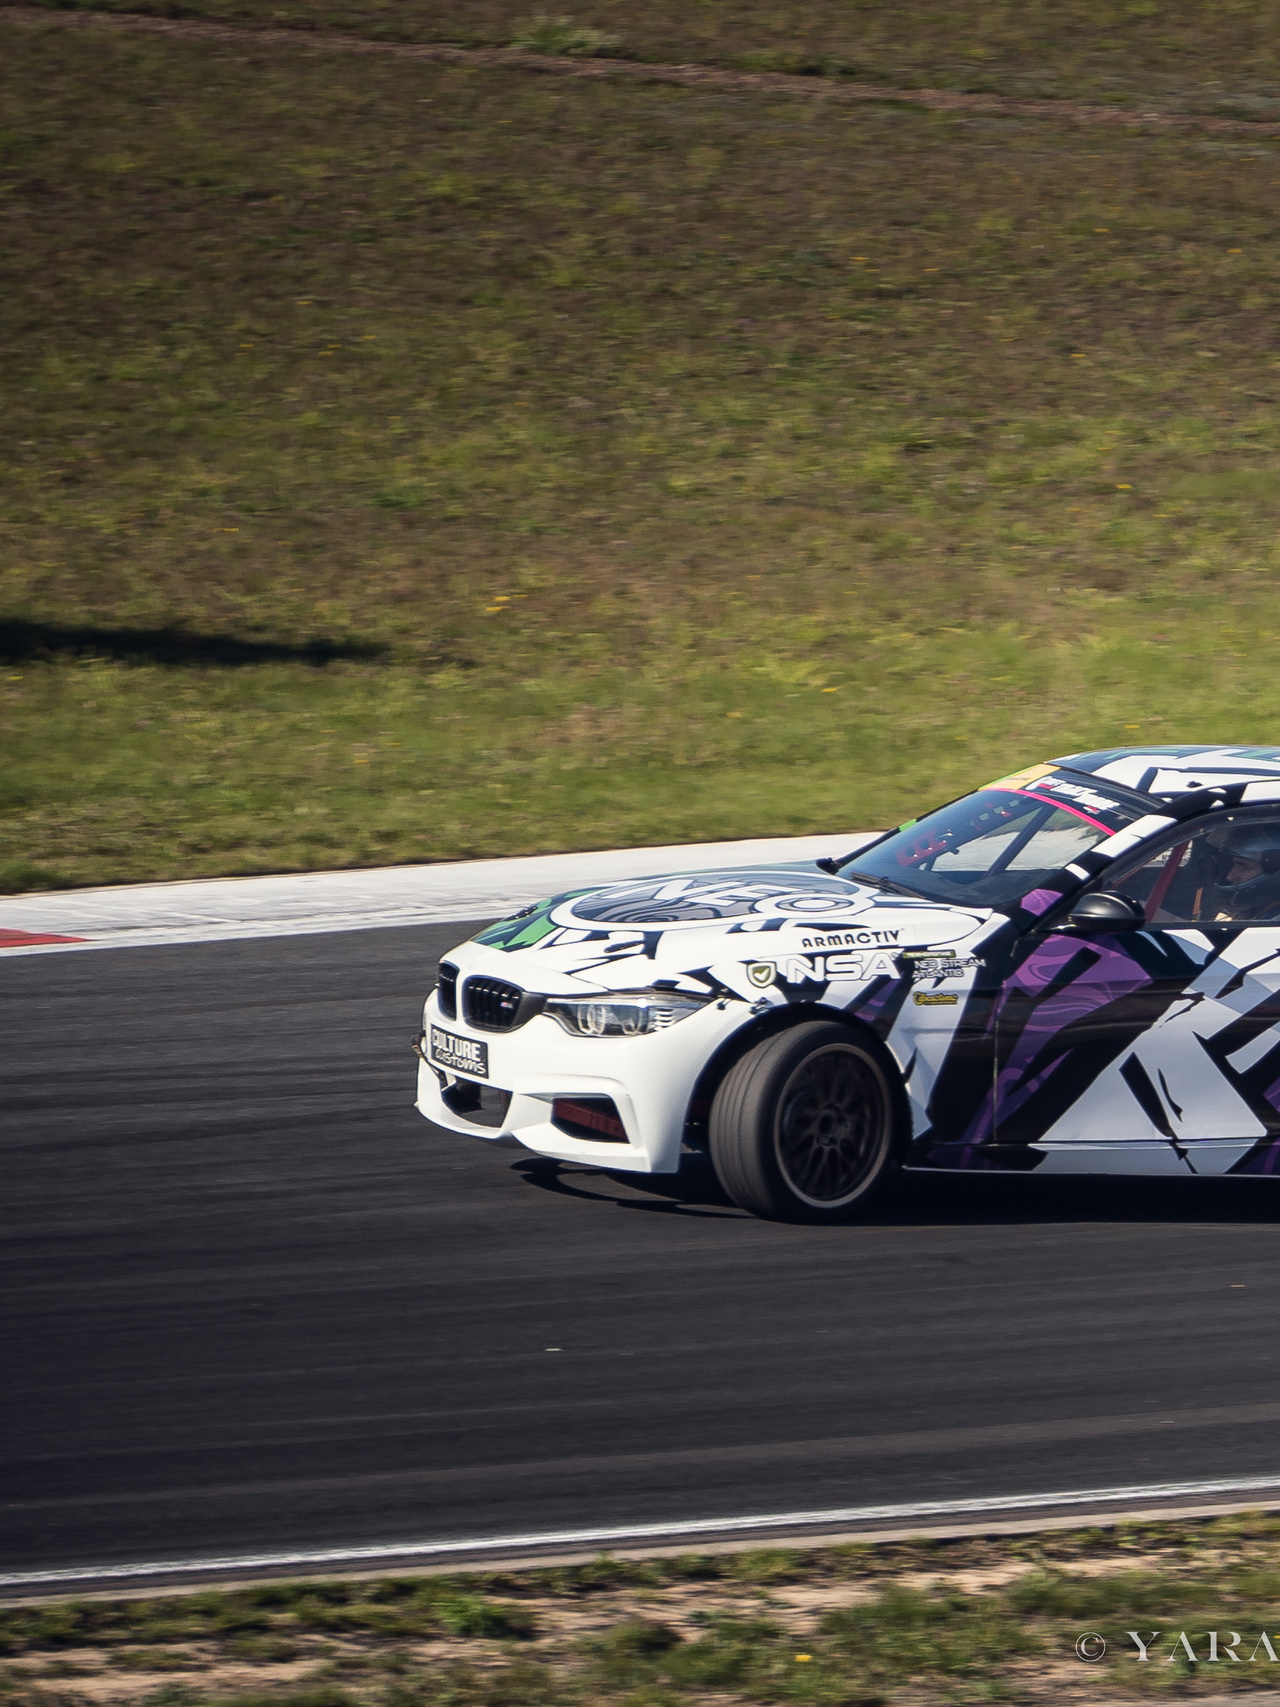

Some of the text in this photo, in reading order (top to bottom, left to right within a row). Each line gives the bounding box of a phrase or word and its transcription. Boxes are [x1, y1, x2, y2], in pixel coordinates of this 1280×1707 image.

[801, 929, 901, 948] ARMACTIV
[786, 952, 901, 984] NSA
[432, 1028, 482, 1062] CULTURE
